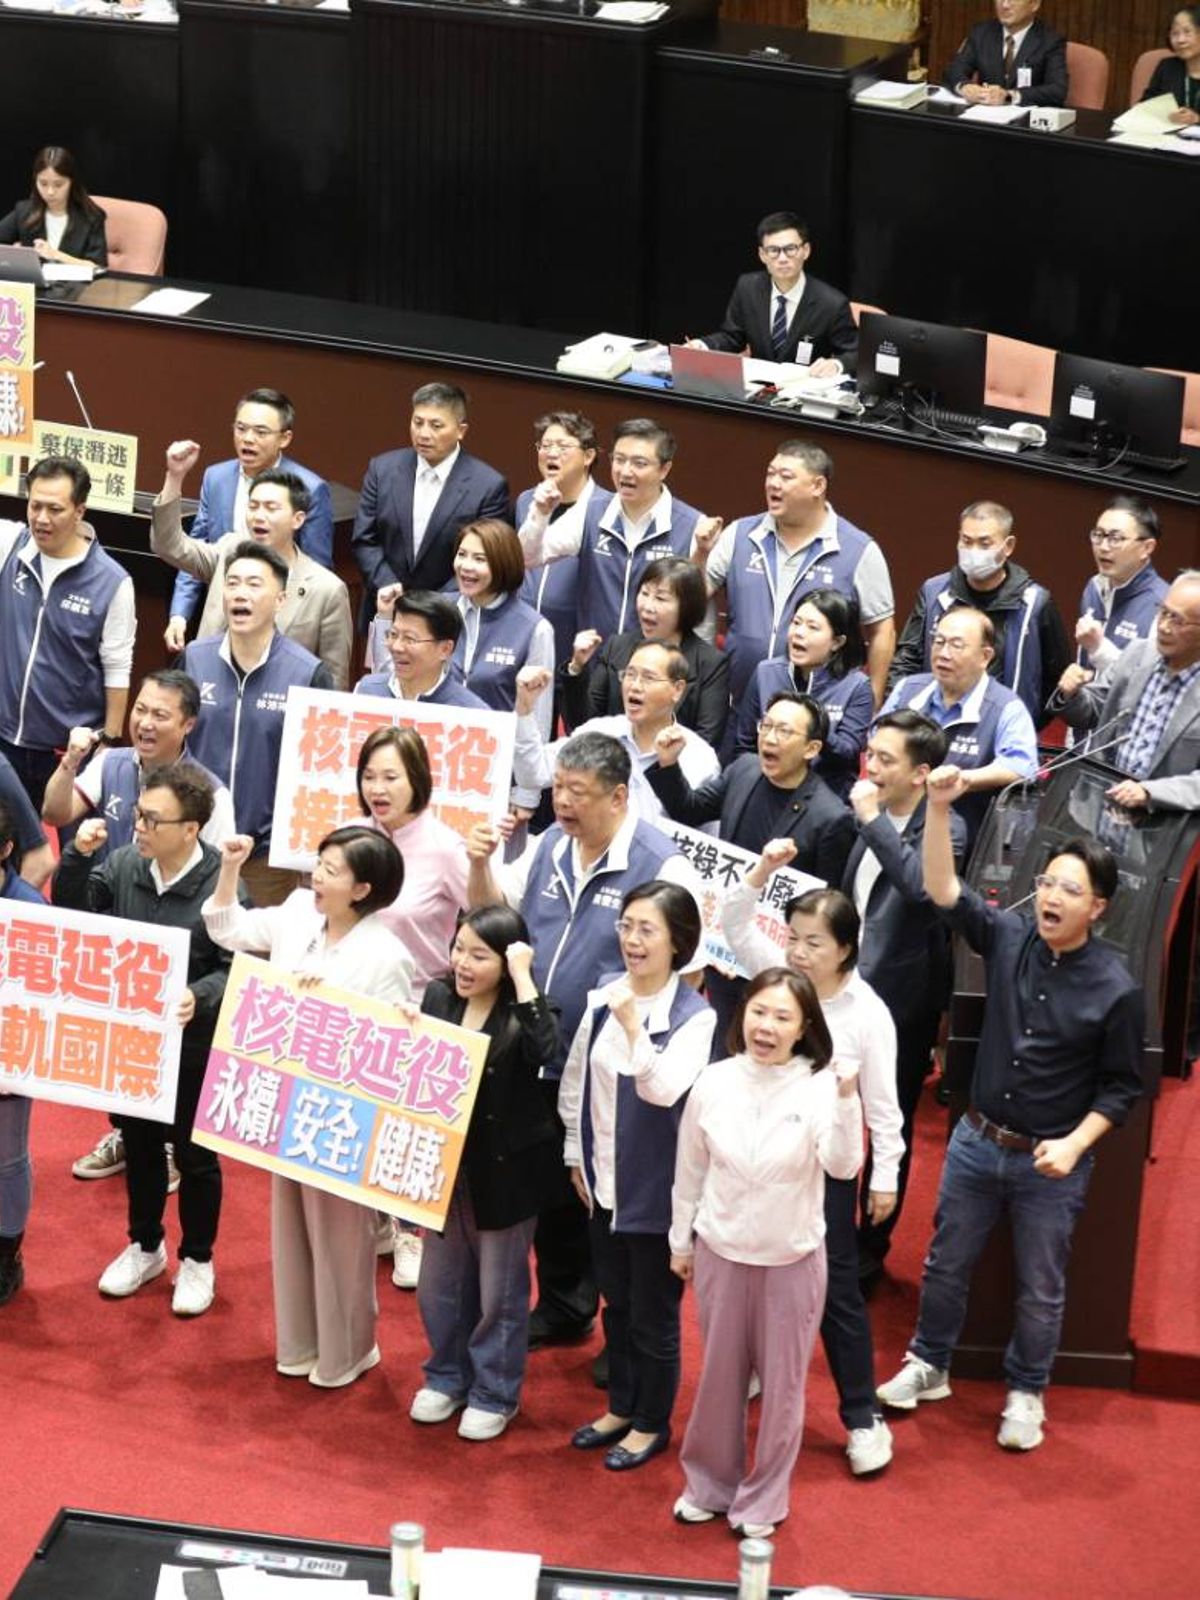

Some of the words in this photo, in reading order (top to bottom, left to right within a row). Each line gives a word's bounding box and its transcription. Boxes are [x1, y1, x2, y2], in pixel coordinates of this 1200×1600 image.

[41, 433, 128, 468] 棄保潛逃
[230, 976, 471, 1122] 核電延役
[284, 1086, 363, 1174] 安全!
[368, 1113, 445, 1201] 健康!
